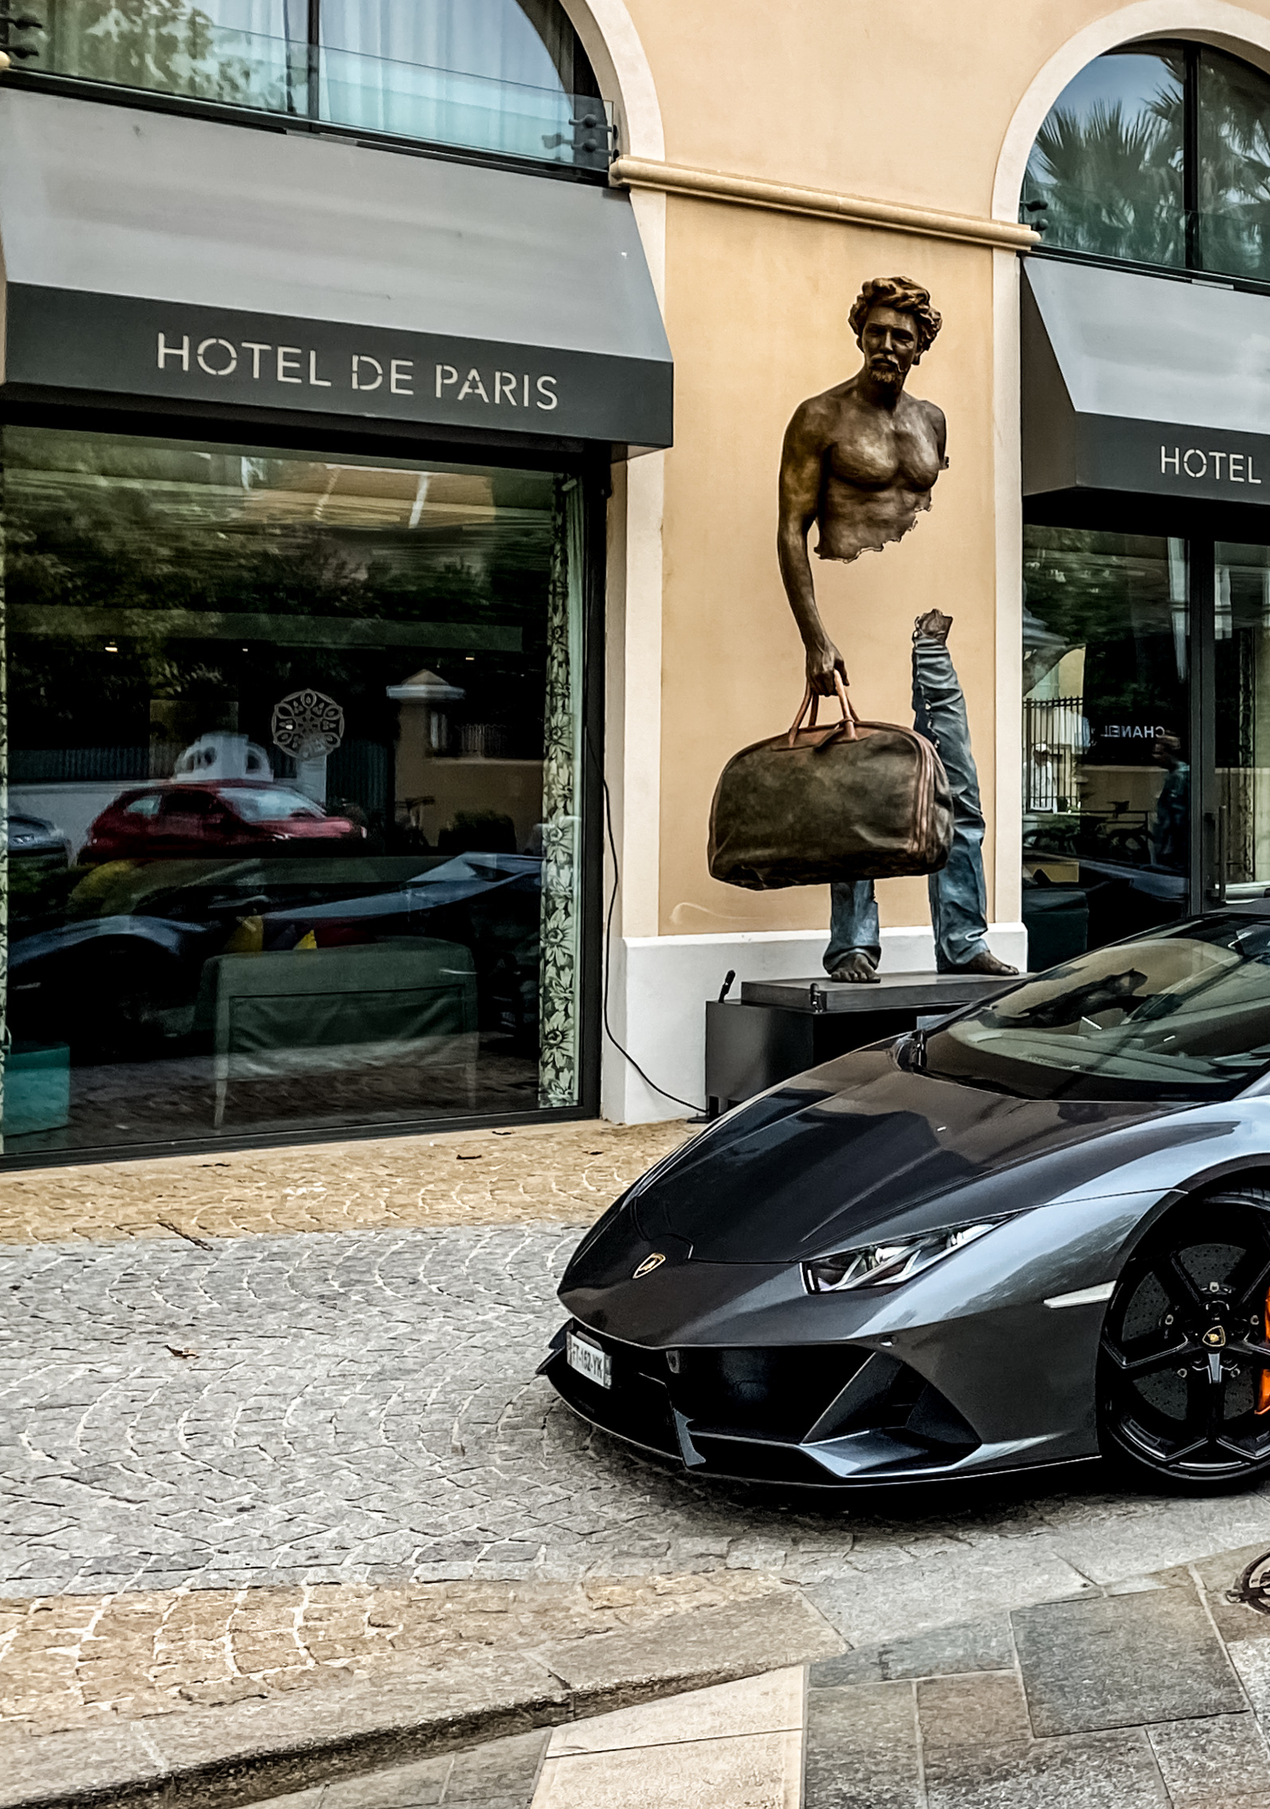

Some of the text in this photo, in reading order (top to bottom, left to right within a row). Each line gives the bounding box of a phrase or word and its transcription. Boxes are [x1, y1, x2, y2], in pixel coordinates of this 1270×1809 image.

[157, 332, 559, 411] HOTEL DE PARIS
[1161, 445, 1262, 484] HOTEL
